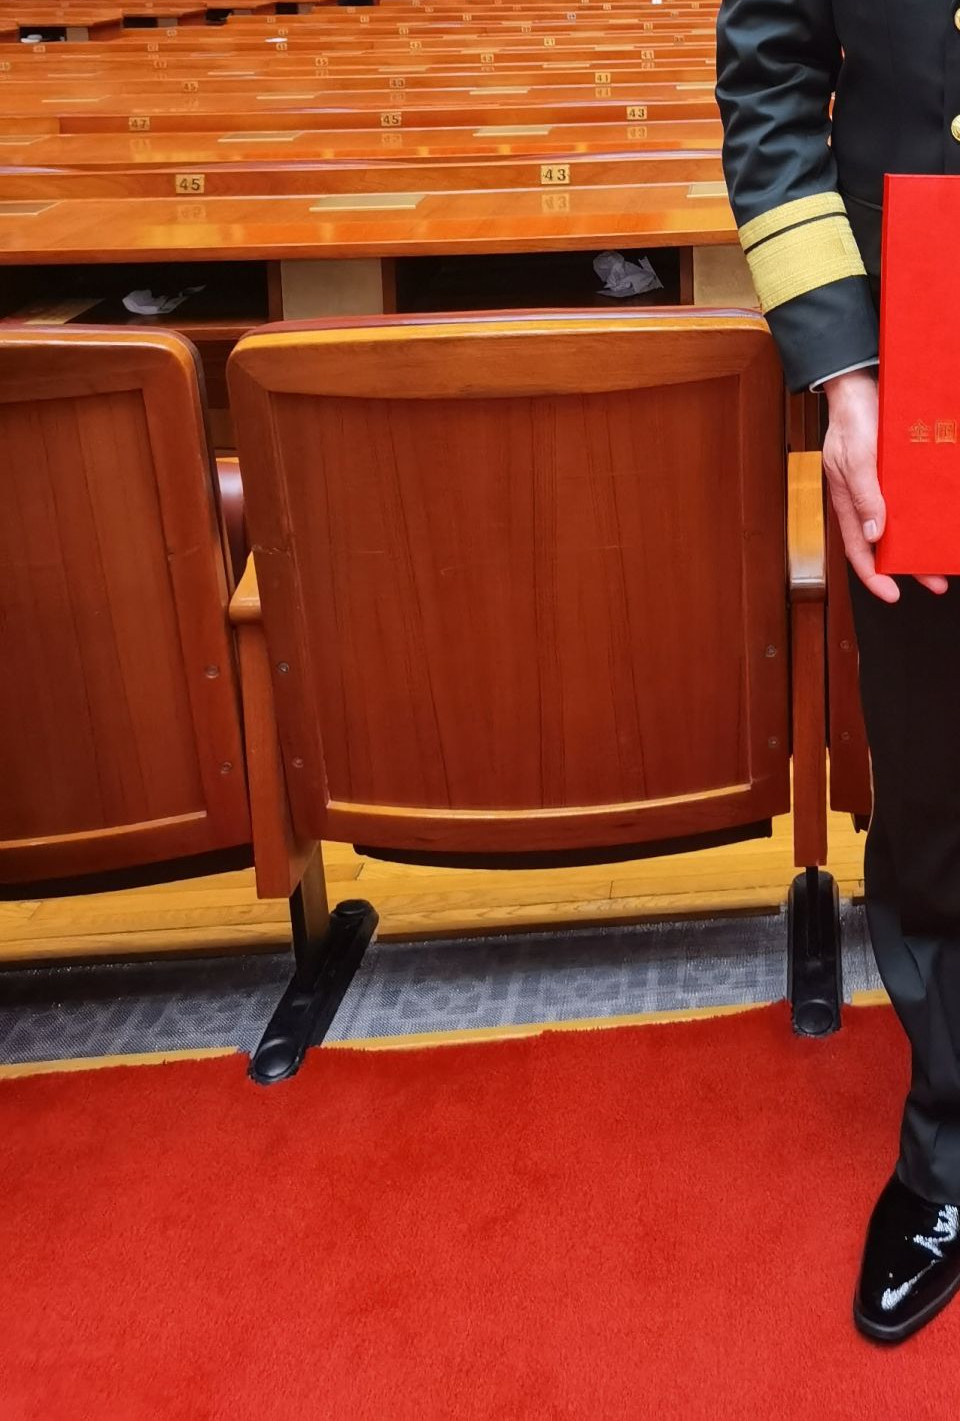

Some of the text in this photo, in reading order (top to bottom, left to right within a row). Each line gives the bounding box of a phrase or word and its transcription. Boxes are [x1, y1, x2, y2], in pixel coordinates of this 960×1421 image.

[628, 107, 646, 119] 43
[130, 118, 148, 129] 47
[382, 114, 400, 125] 45
[544, 167, 567, 182] 43
[178, 177, 201, 192] 45
